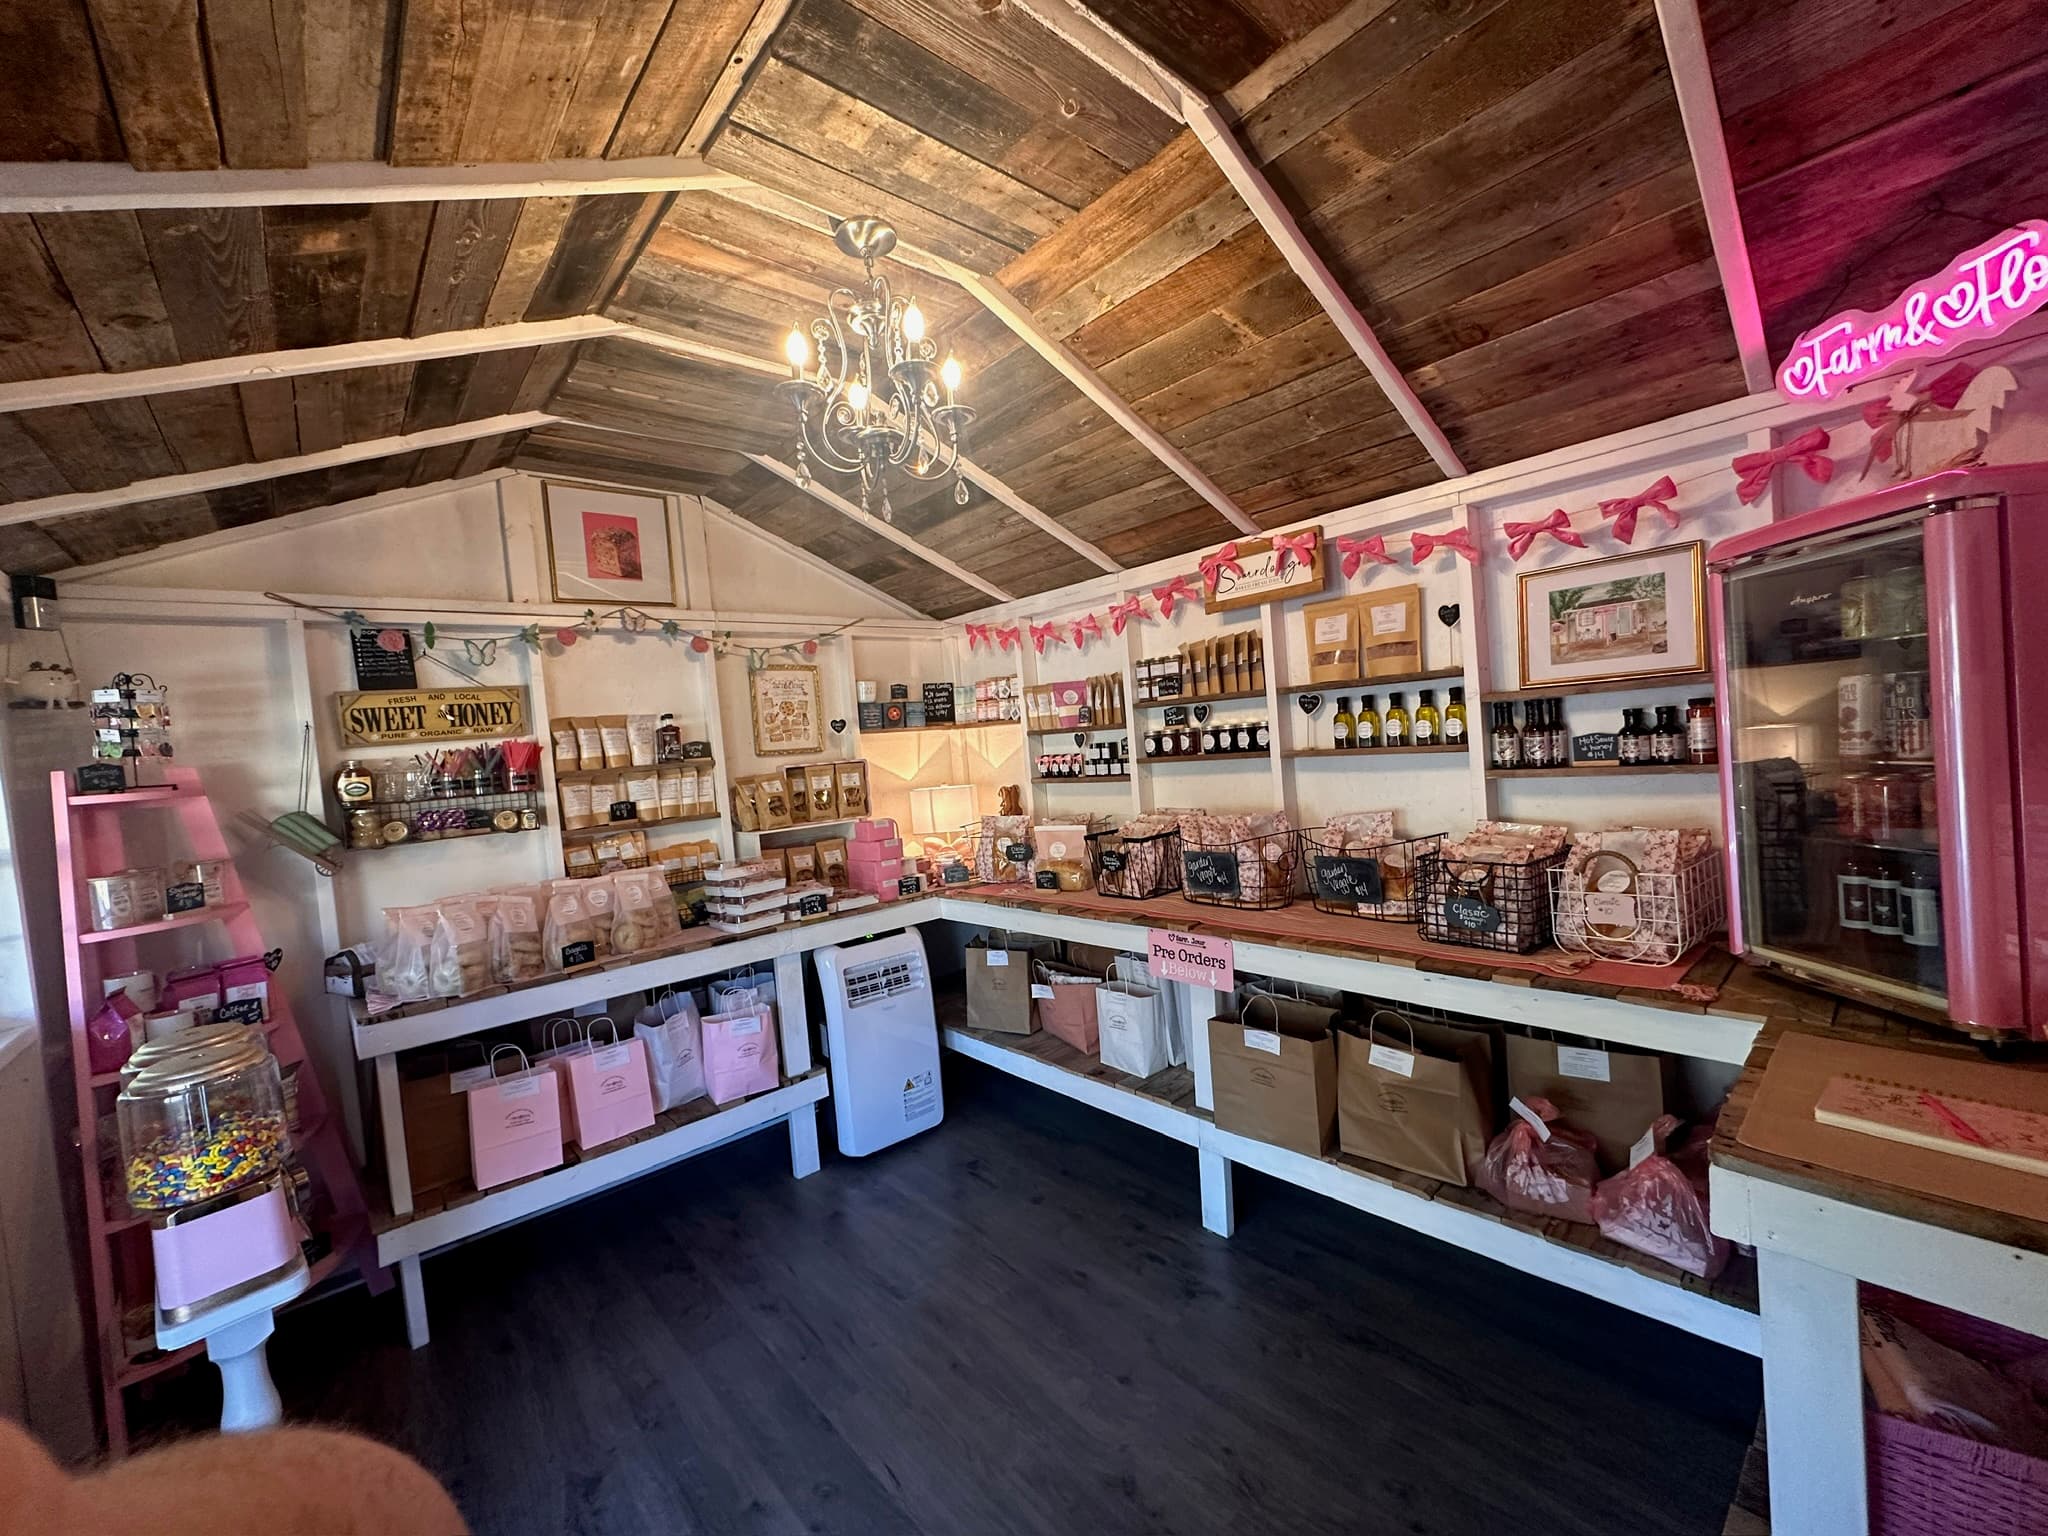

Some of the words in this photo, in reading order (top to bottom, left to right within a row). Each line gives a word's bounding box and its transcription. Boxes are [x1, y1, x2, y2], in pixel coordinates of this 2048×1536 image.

[387, 695, 417, 705] FRESH
[428, 693, 446, 701] AND
[454, 693, 481, 701] LOCAL
[350, 705, 426, 734] SWEET
[446, 702, 513, 728] HONEY
[380, 732, 407, 740] PURE
[419, 728, 462, 738] ORGANIC
[473, 726, 494, 734] RAW
[1578, 735, 1594, 746] Hot
[1452, 903, 1491, 919] Classic
[1152, 944, 1176, 960] Pre
[1178, 948, 1226, 970] Orders
[1168, 961, 1208, 981] Below
